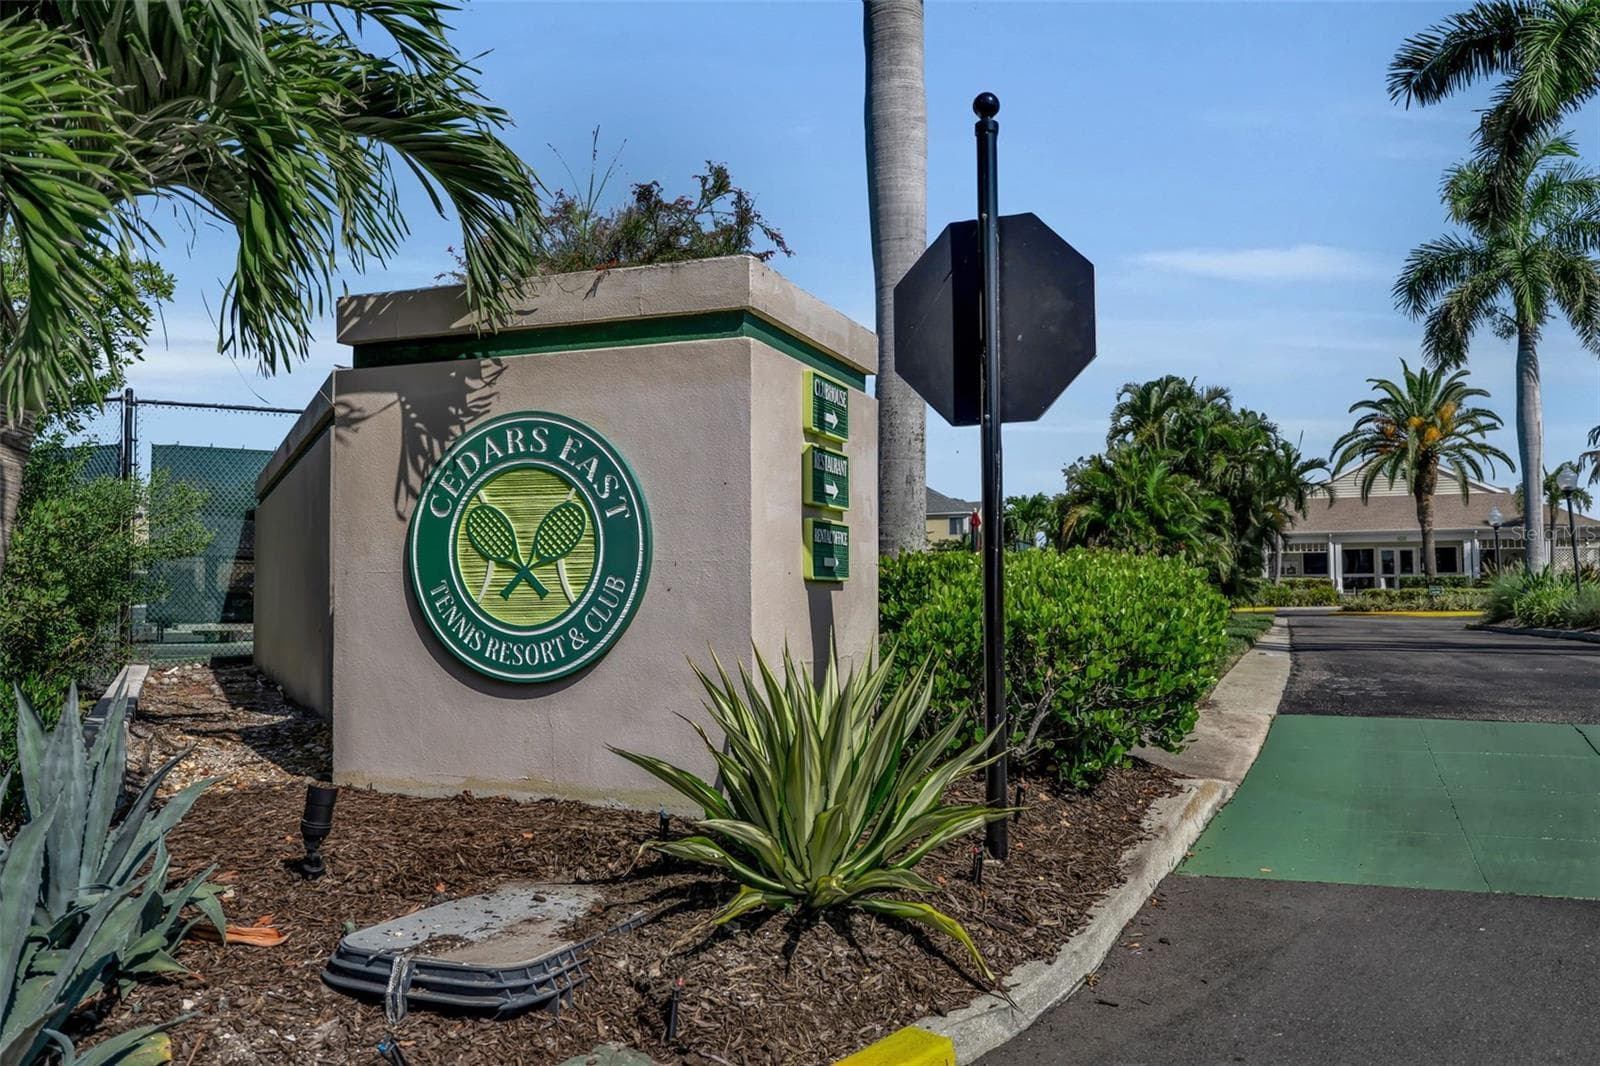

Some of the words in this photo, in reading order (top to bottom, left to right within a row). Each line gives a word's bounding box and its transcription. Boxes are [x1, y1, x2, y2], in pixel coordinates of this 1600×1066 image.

[430, 427, 549, 519] CEDARS
[559, 435, 632, 520] EAST
[814, 450, 847, 478] RESTAURANT
[430, 579, 486, 651] TENNIS
[485, 635, 565, 666] RESORT
[570, 627, 589, 651] &
[584, 575, 626, 634] CLUB
